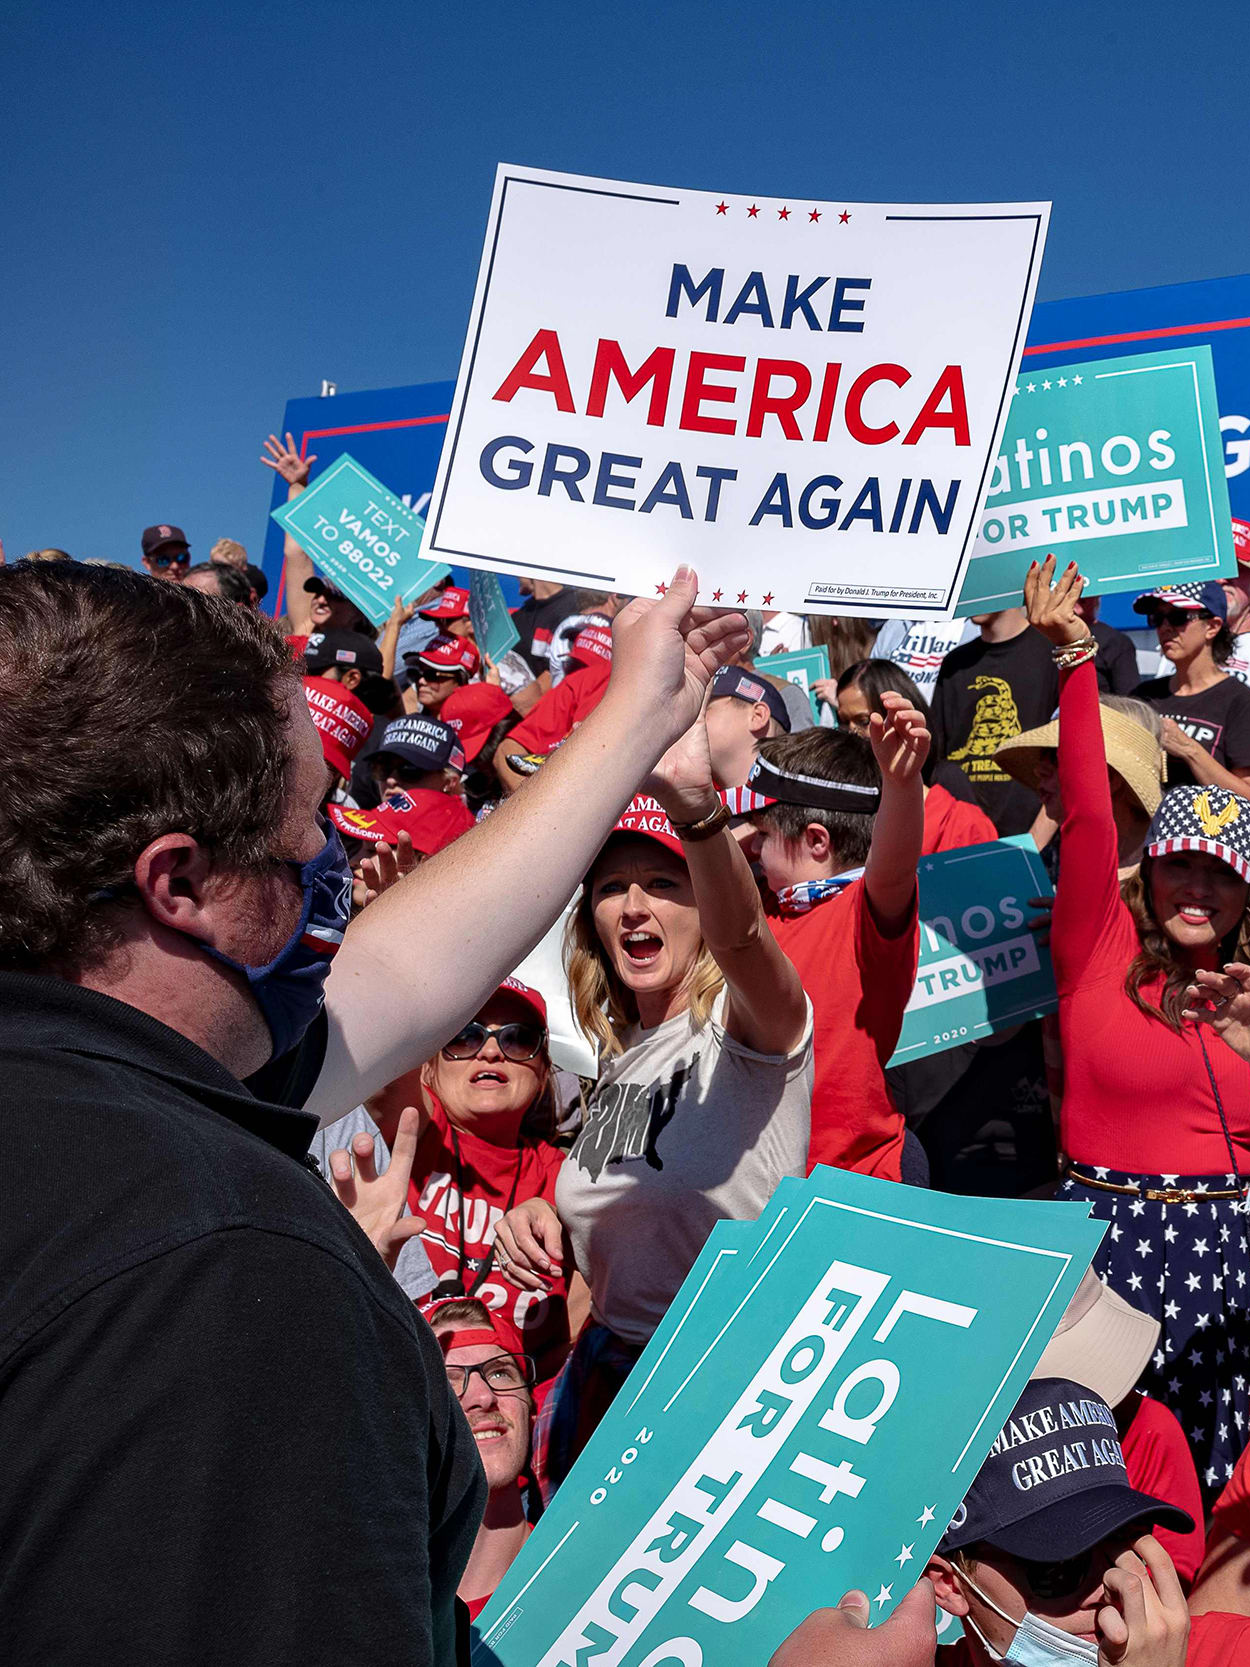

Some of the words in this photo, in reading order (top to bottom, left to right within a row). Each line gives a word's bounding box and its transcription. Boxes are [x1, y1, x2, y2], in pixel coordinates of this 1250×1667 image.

[665, 263, 873, 333] MAKE
[492, 328, 972, 447] AMERICA
[478, 435, 739, 522] GREAT
[749, 472, 961, 535] AGAIN
[339, 508, 401, 568] VAMOS
[363, 501, 411, 542] TEXT
[976, 514, 1029, 544] OR
[1042, 493, 1172, 532] TRUMP
[312, 515, 339, 542] TO
[338, 540, 394, 591] 88022
[814, 585, 828, 593] Paid
[828, 586, 836, 594] for
[837, 586, 844, 596] by
[844, 587, 865, 596] Donald
[871, 588, 890, 598] Trump
[890, 589, 899, 597] for
[899, 590, 928, 599] President,
[928, 591, 938, 599] Inc.
[304, 687, 333, 711] MAKE
[404, 718, 448, 742] AMERICA
[407, 733, 439, 752] AGAIN
[341, 822, 384, 841] PRESIDENT
[919, 895, 1024, 957] nos
[918, 947, 1027, 997] TRUMP
[933, 1025, 968, 1046] 2020
[736, 1287, 862, 1438] FOR
[989, 1406, 1060, 1458] MAKE
[590, 1426, 654, 1506] 2020
[1012, 1441, 1091, 1491] GREAT
